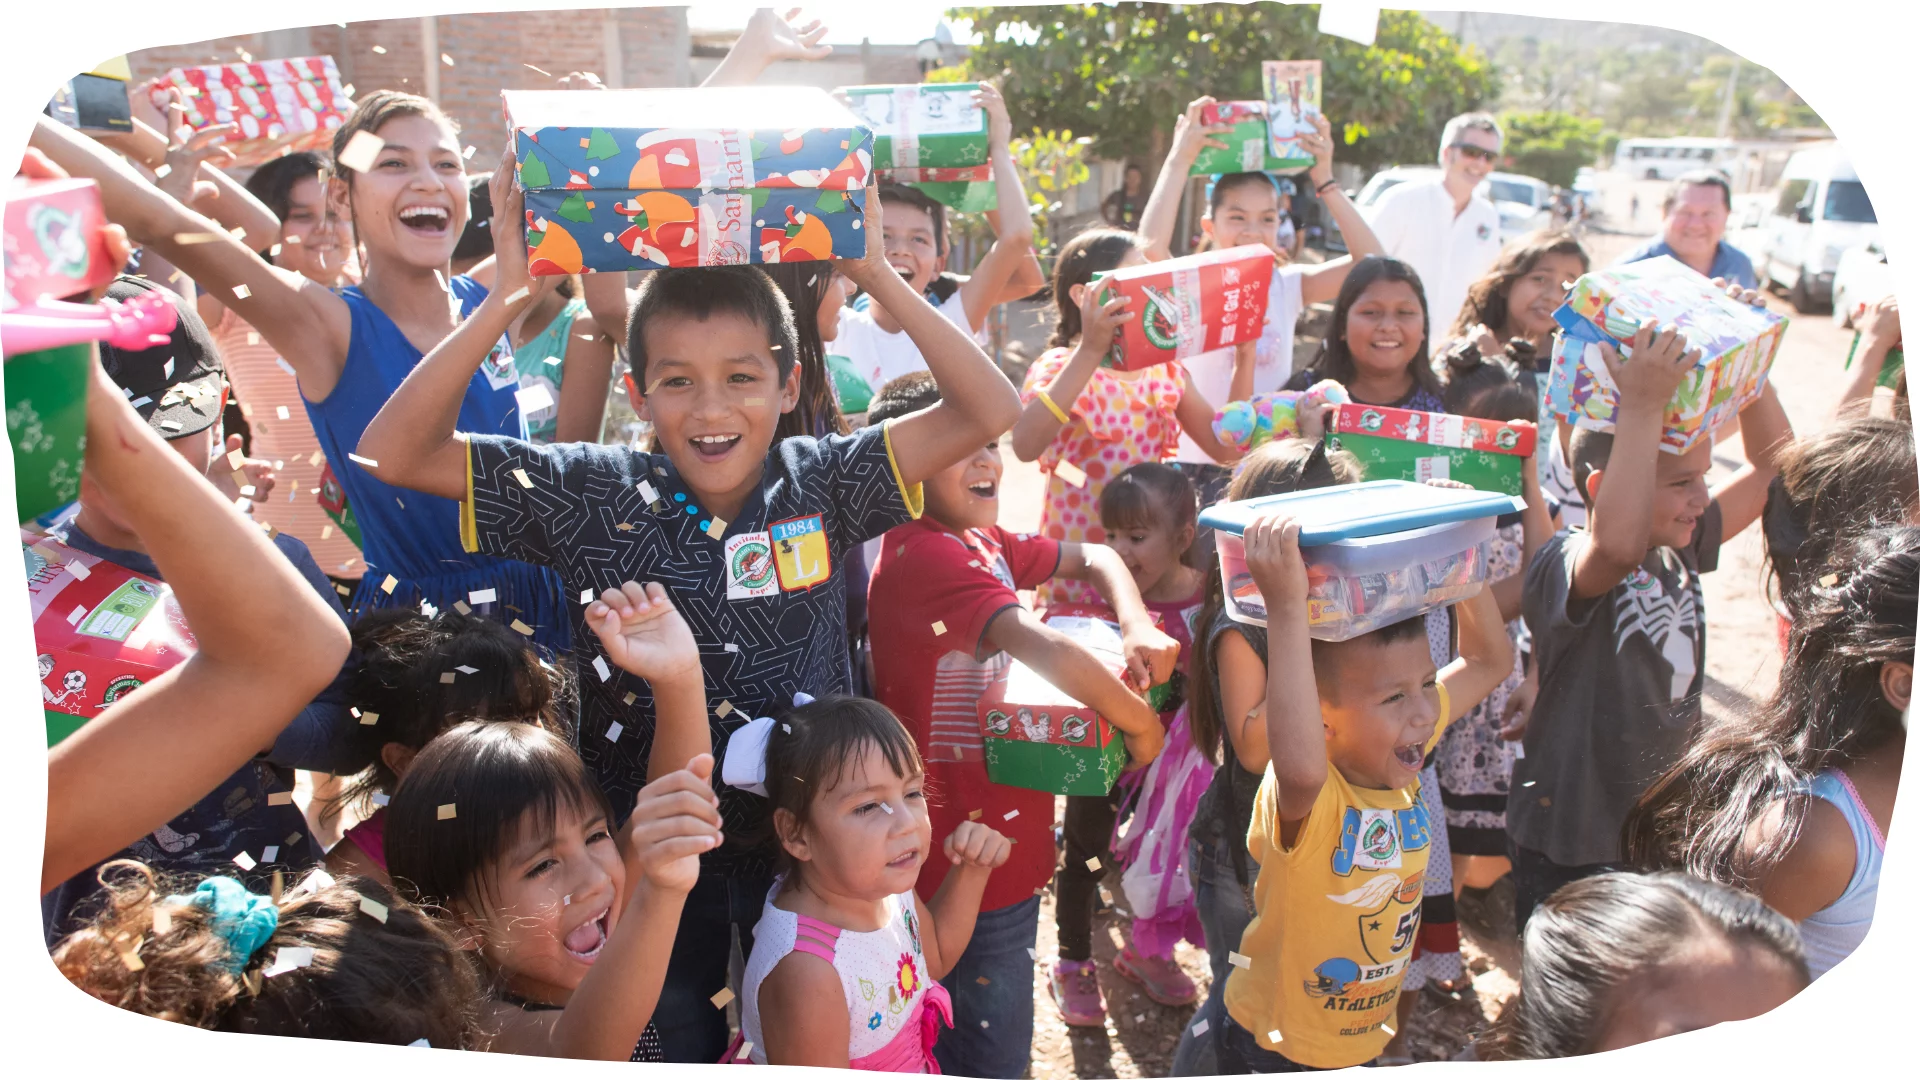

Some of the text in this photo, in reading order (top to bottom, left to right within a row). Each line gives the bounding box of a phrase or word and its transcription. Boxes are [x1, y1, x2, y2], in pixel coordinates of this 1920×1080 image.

[779, 519, 817, 539] 1984
[728, 534, 766, 552] Invitado
[789, 541, 820, 581] L
[750, 573, 777, 596] Especial
[1389, 900, 1421, 953] 57
[1364, 964, 1395, 981] EST.
